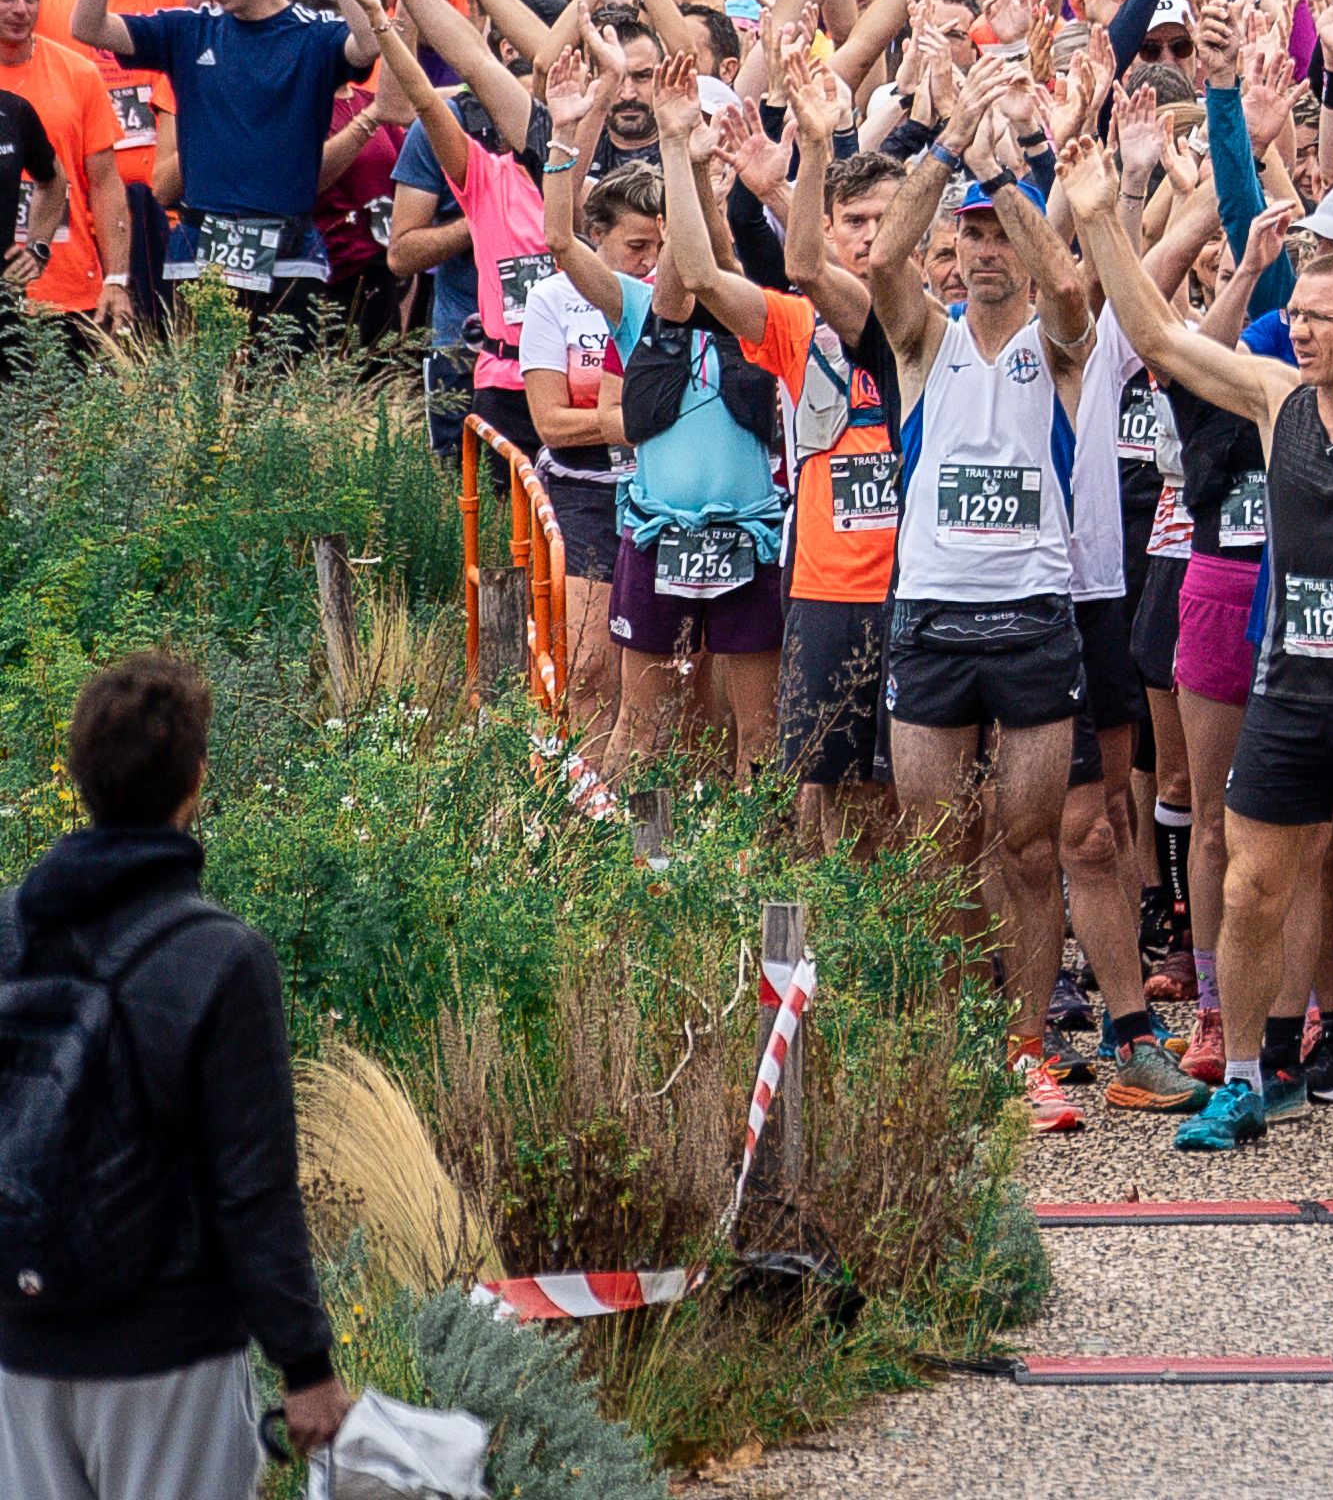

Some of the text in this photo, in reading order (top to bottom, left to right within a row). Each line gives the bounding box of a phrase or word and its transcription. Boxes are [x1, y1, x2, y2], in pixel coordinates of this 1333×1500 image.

[210, 240, 257, 271] 1265
[853, 454, 889, 467] TRAIL 12
[965, 468, 1018, 480] TRAIL 12 KM
[958, 494, 1019, 523] 1299
[678, 551, 733, 578] 1256
[1304, 581, 1326, 591] TRAIL
